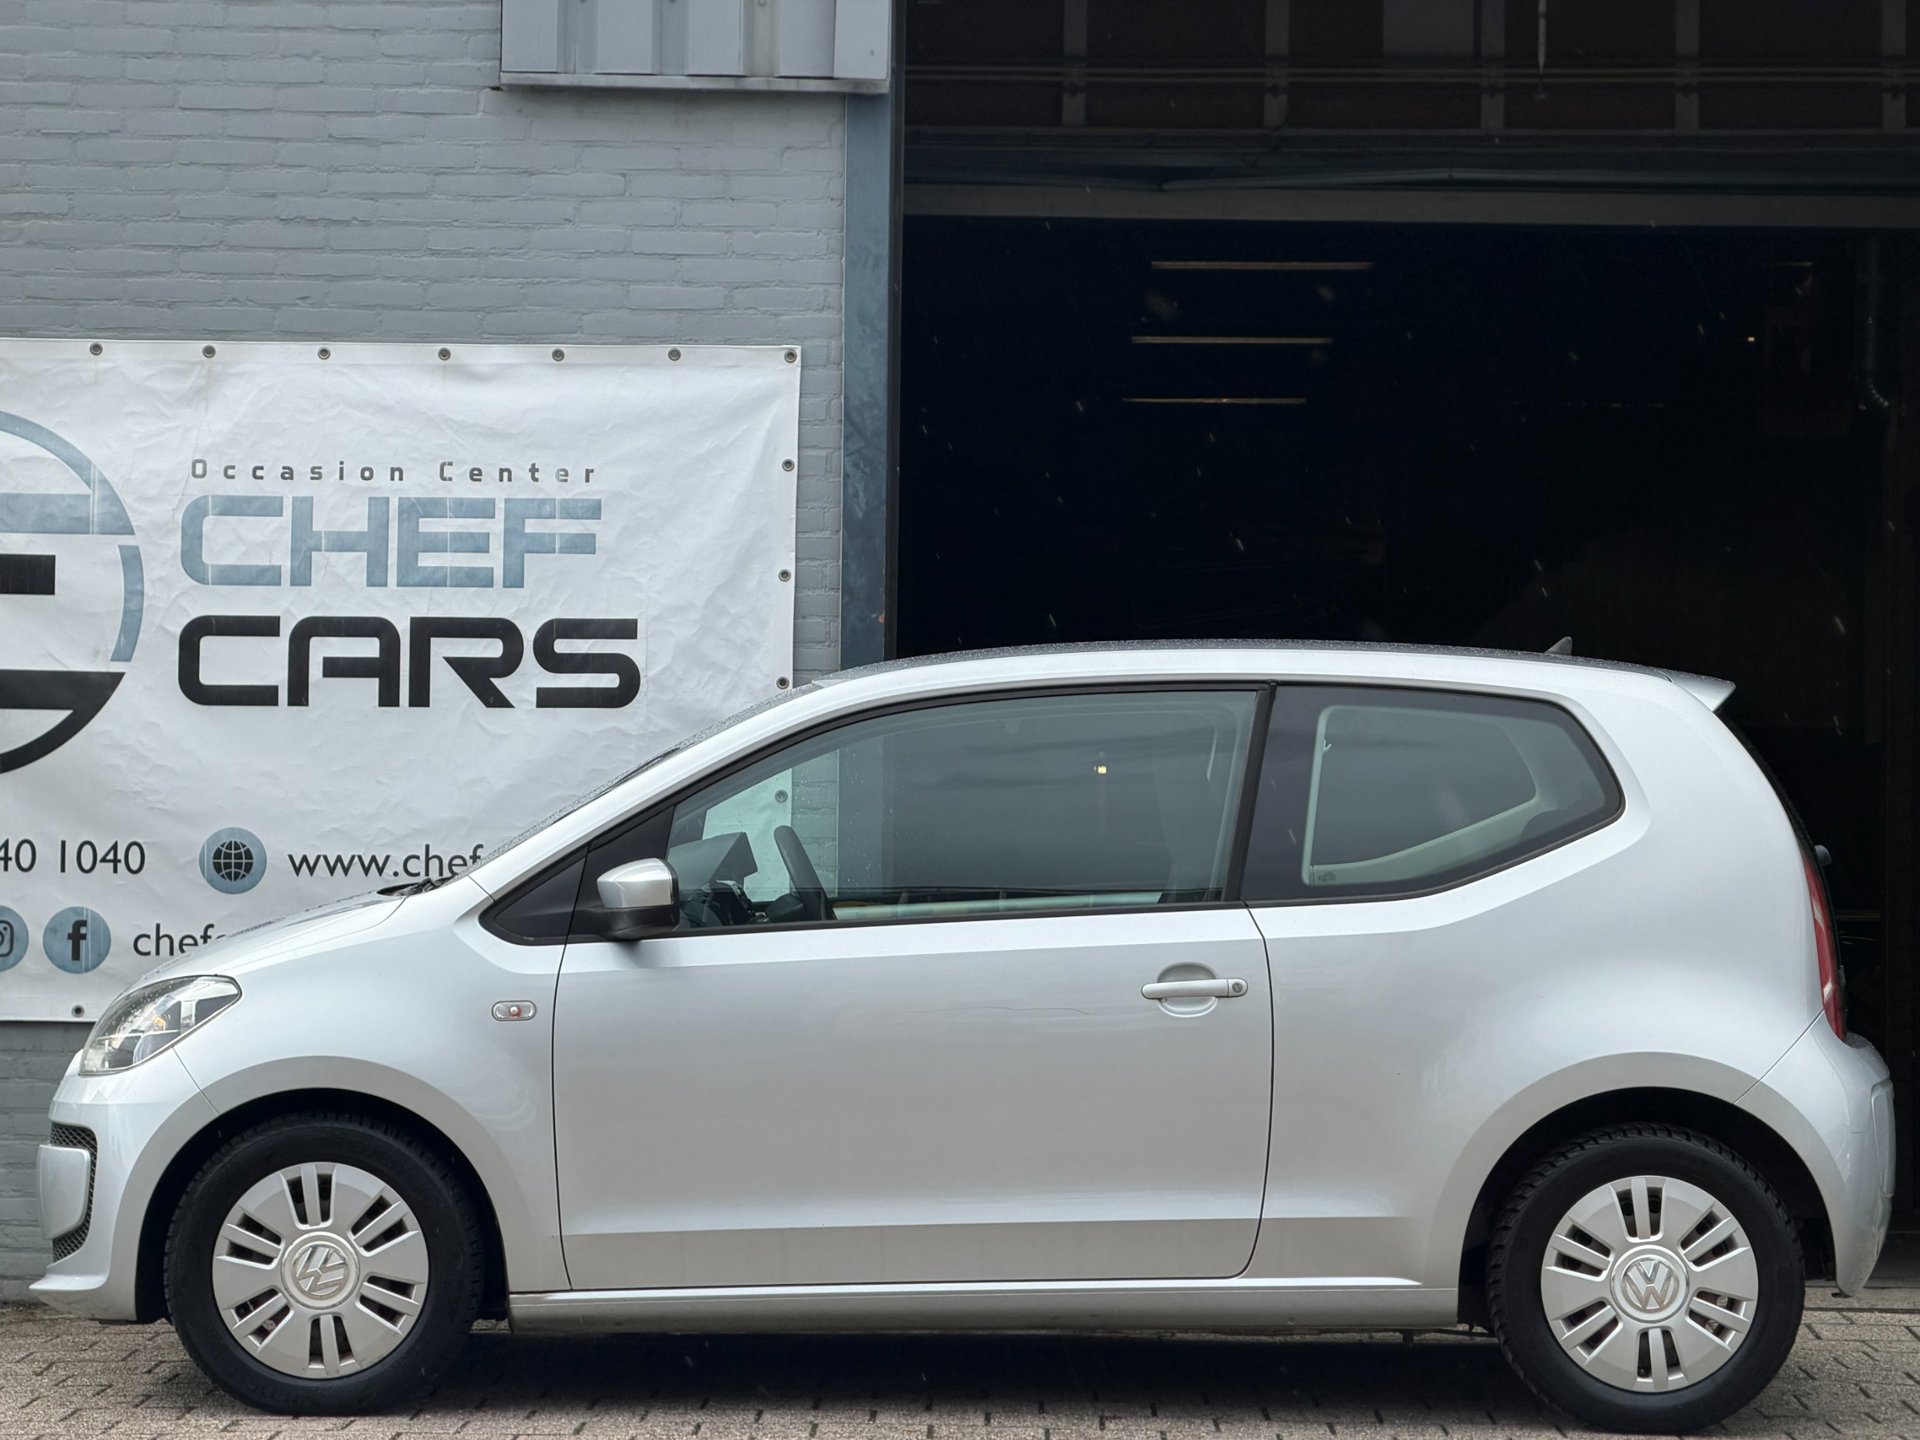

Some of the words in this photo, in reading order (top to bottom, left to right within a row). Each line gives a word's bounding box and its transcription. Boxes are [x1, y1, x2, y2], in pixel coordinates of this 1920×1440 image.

[191, 458, 405, 482] Occasion
[439, 460, 596, 483] Center
[180, 495, 602, 589] CHEF
[178, 615, 641, 709] CARS
[60, 839, 146, 875] 1040
[133, 922, 227, 956] chef
